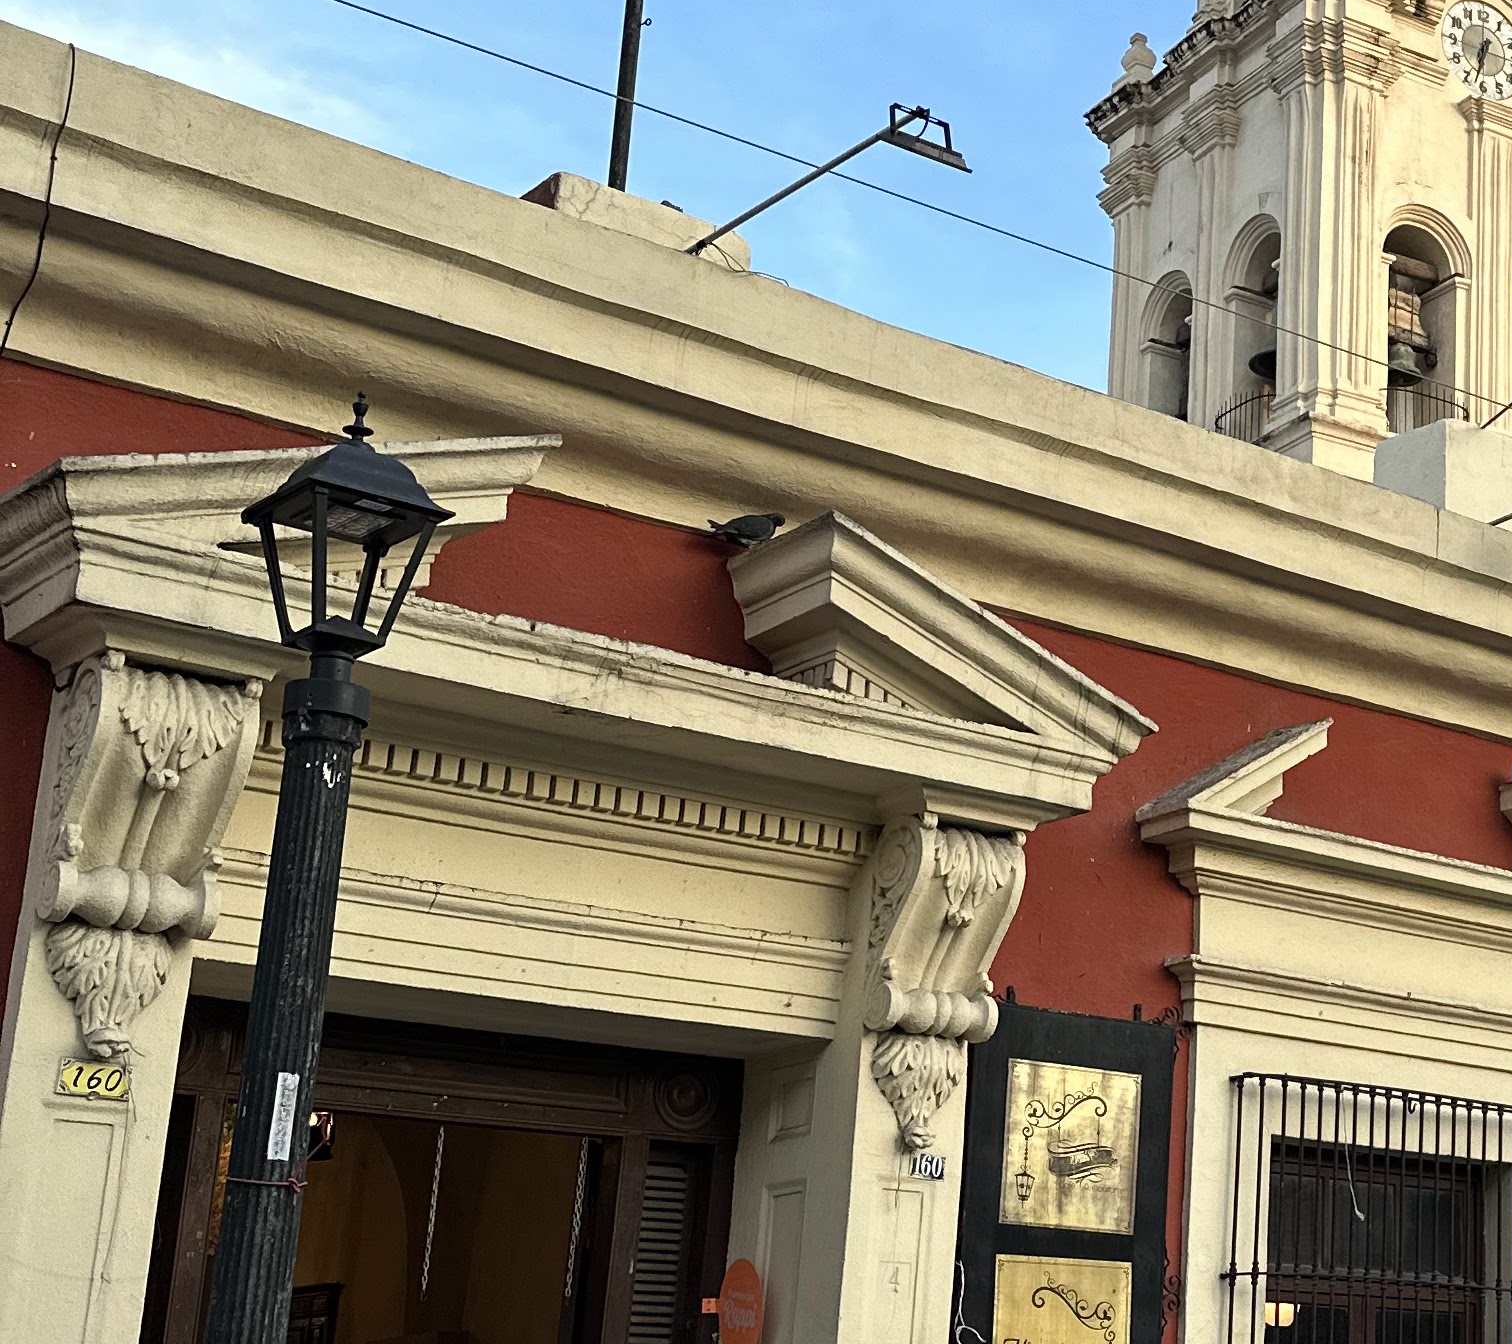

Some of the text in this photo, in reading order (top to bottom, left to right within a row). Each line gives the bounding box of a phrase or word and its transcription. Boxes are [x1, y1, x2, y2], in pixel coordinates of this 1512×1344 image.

[1451, 16, 1462, 29] 10
[1477, 10, 1489, 23] 12
[1496, 21, 1502, 32] 1
[1449, 33, 1457, 45] 9
[1453, 52, 1460, 64] 8
[1479, 81, 1487, 93] 6
[1495, 82, 1503, 95] 5
[73, 1066, 122, 1092] 160
[914, 1154, 943, 1177] 160
